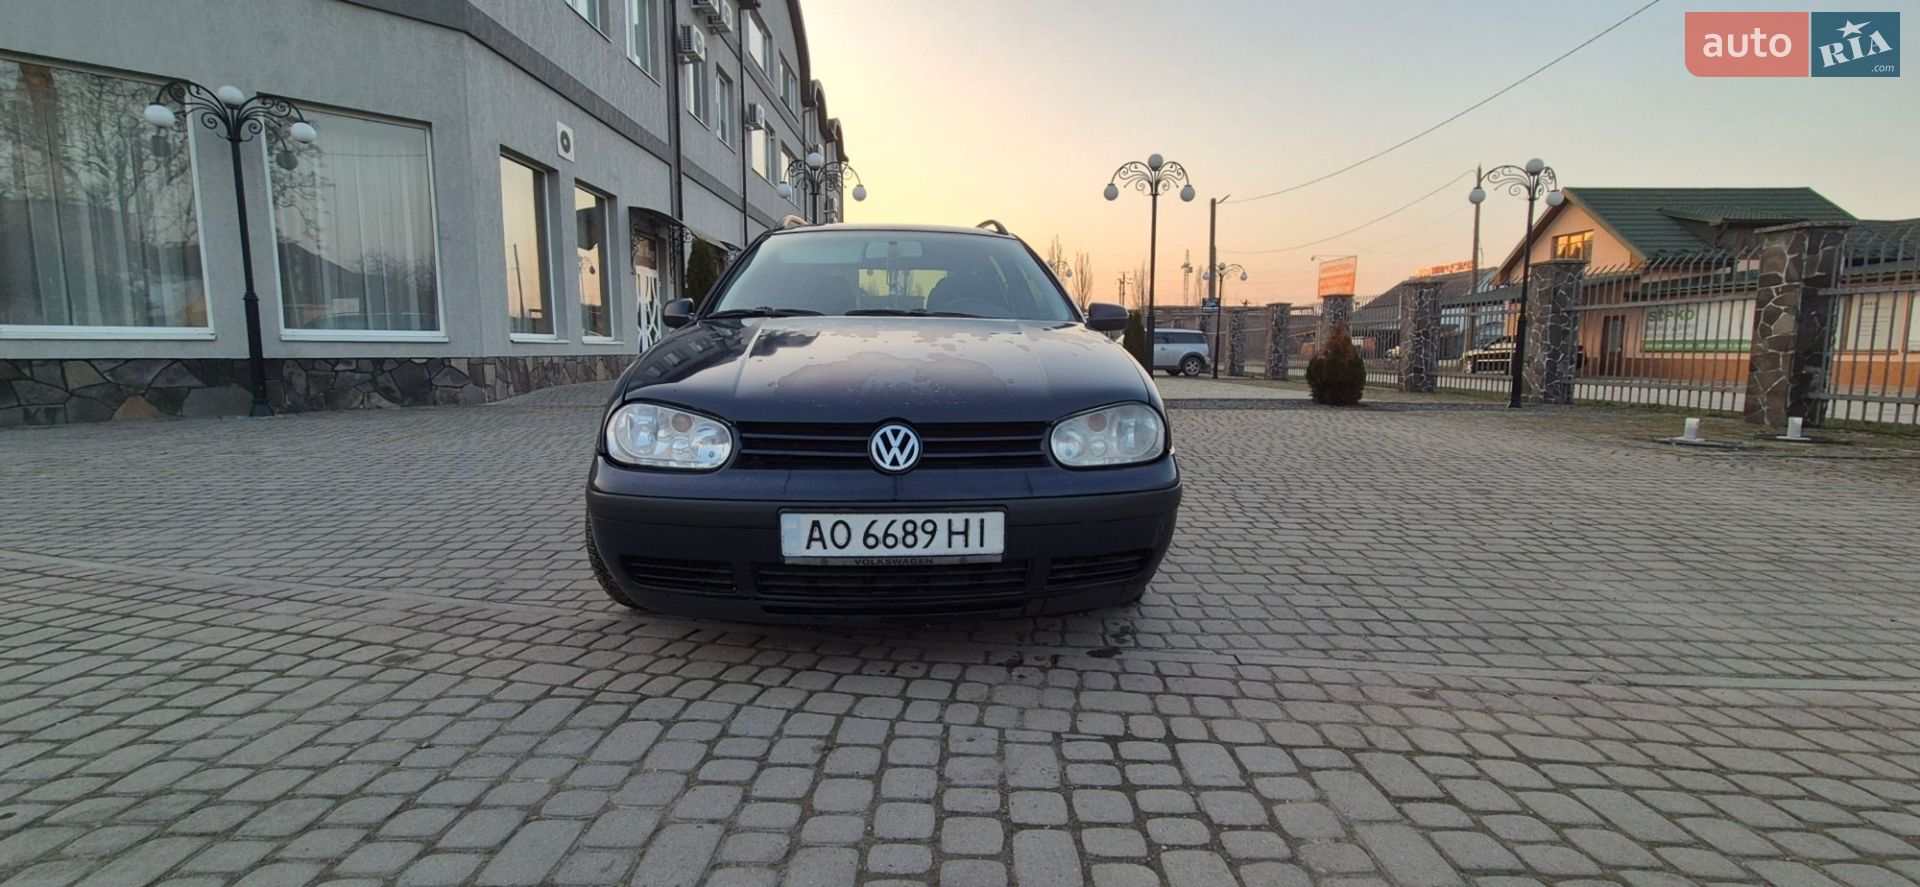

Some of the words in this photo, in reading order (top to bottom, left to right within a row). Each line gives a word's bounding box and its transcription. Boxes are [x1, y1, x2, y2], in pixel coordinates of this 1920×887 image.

[862, 519, 938, 550] 6689
[947, 518, 985, 549] HI
[854, 558, 934, 566] VOLKSWAGEN
